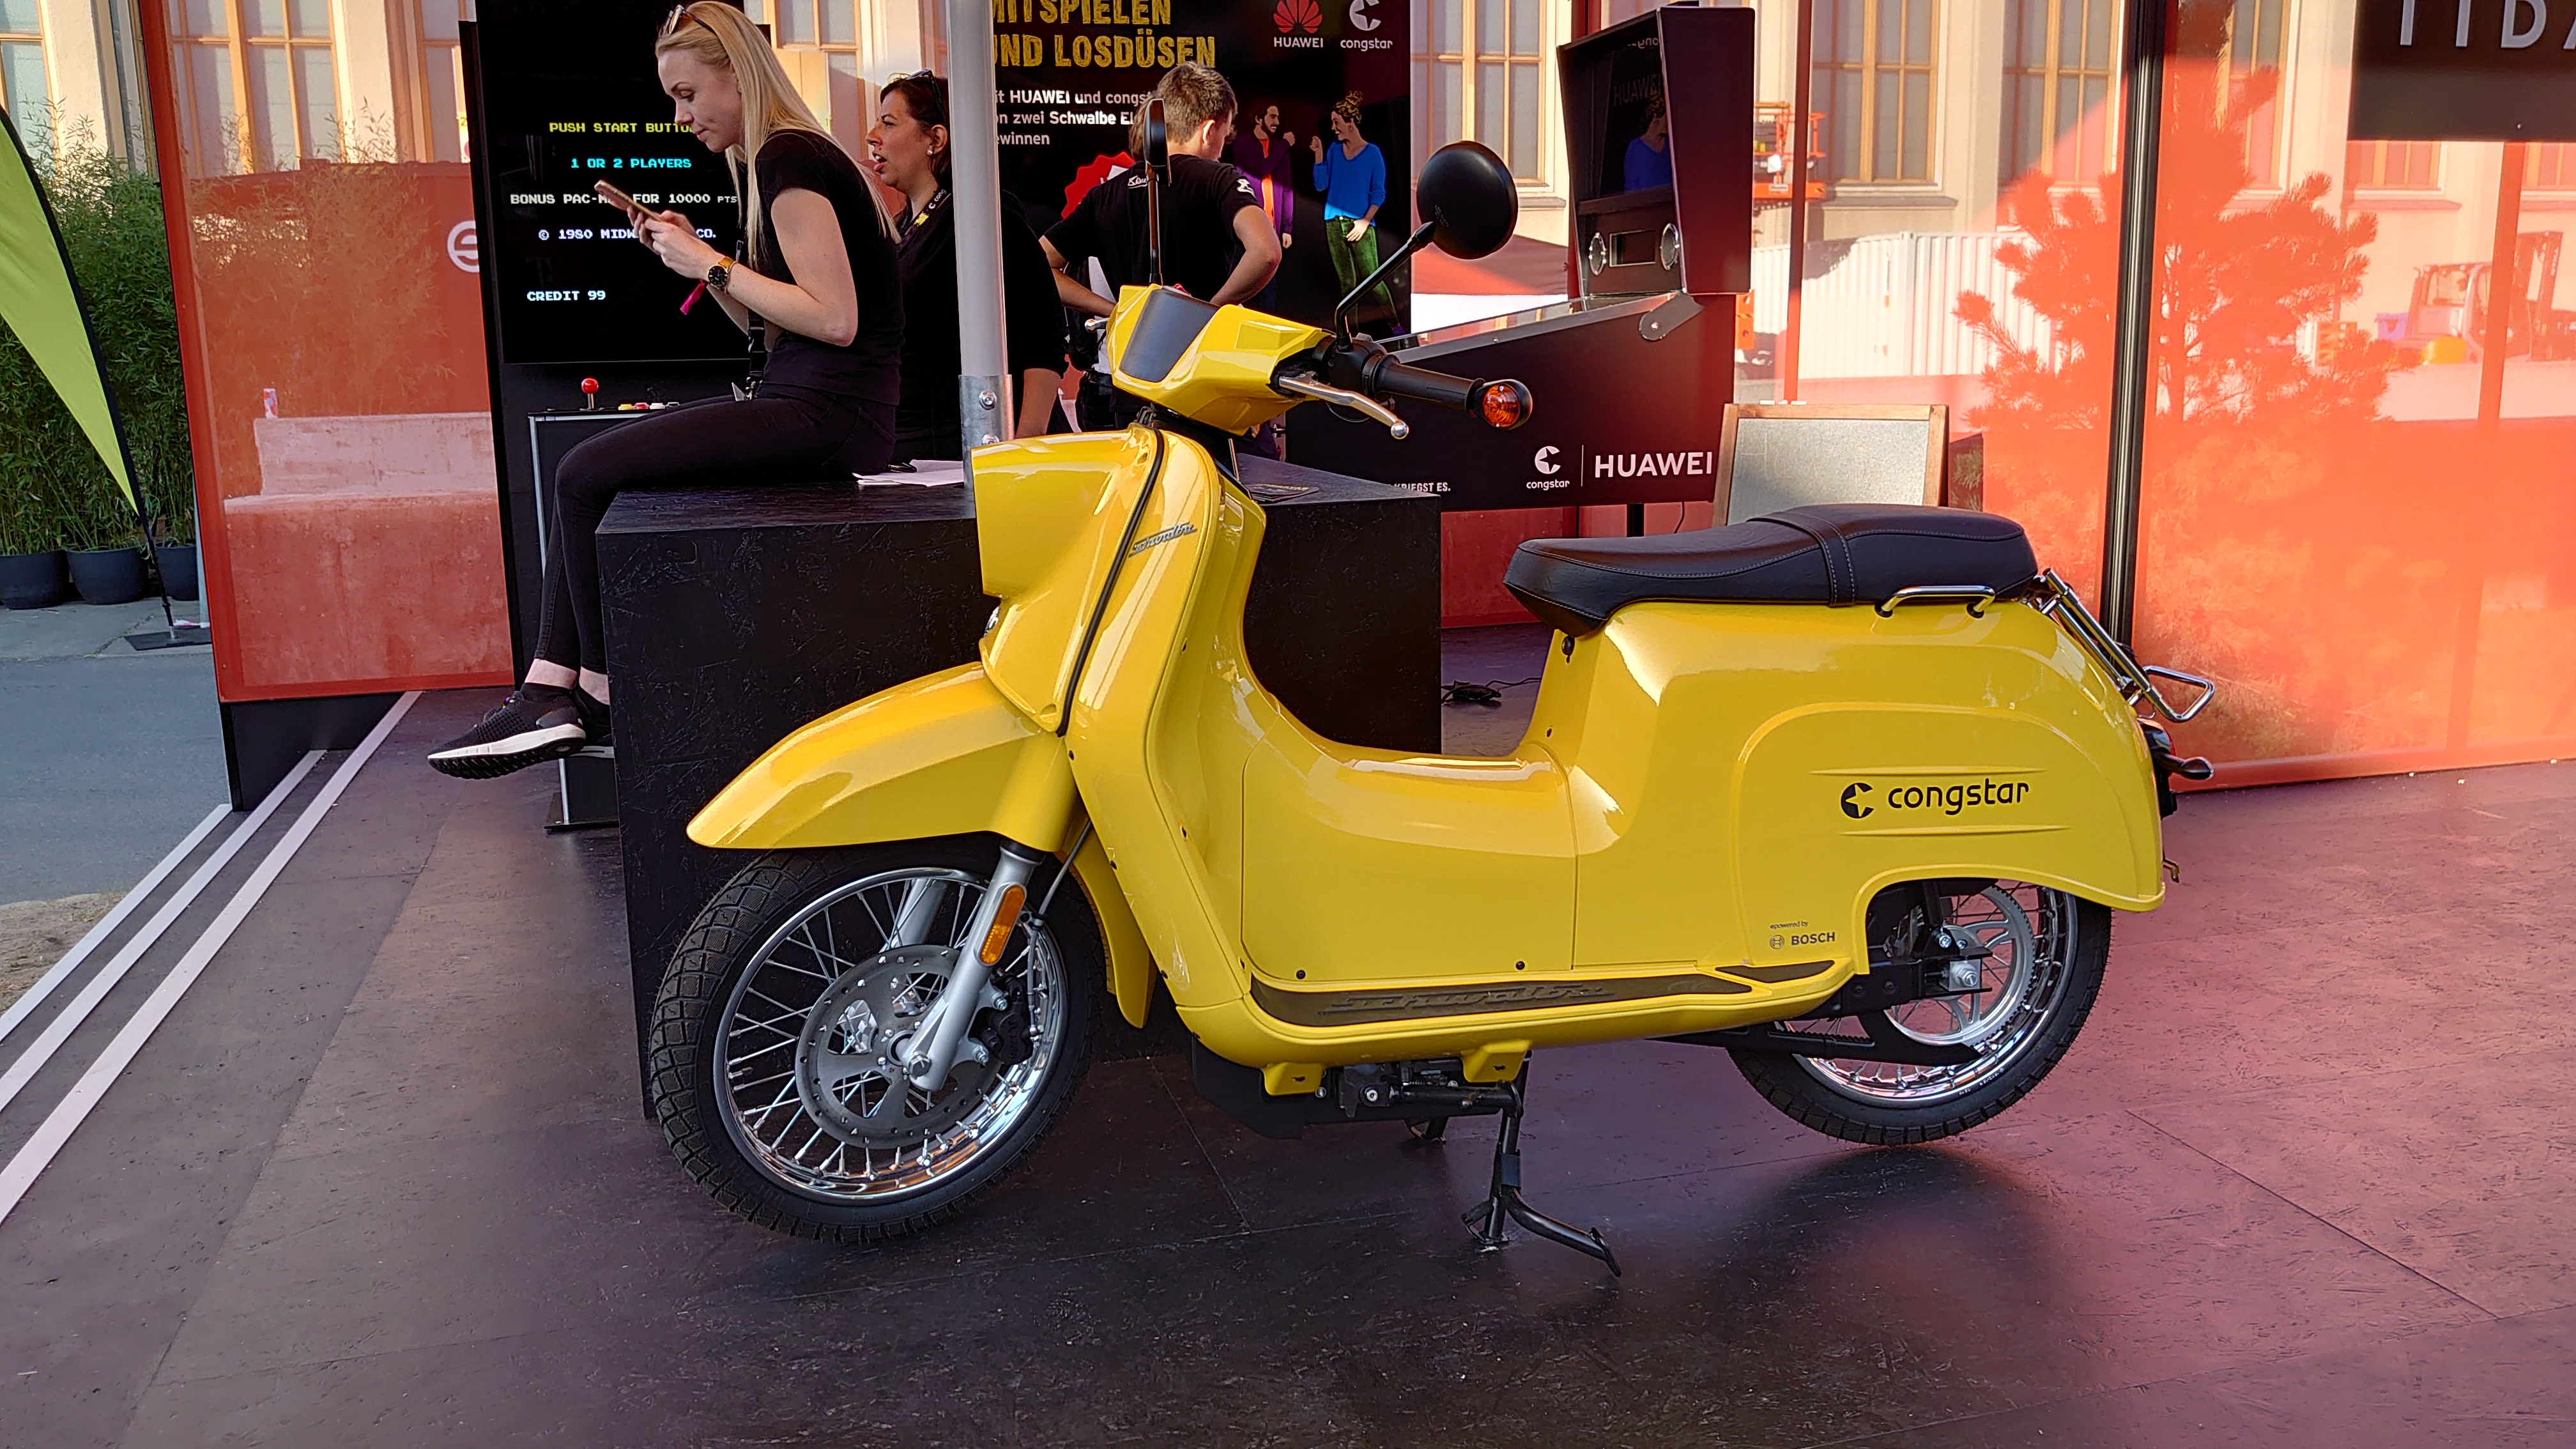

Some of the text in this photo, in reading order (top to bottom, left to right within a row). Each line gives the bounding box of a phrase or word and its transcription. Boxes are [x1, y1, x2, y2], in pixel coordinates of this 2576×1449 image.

[2400, 0, 2576, 50] ID
[993, 28, 1216, 68] ND LOSDÜSEN
[1273, 36, 1324, 48] HUAWEI
[1340, 37, 1393, 52] congstar
[1009, 90, 1070, 104] HUAWEI
[1075, 91, 1101, 104] und
[1013, 111, 1045, 125] zwei
[1049, 111, 1117, 125] Schwalbe
[549, 122, 693, 133] PUSH START BUTTO
[571, 158, 692, 169] 1 OR 2 PLAYERS
[510, 193, 738, 204] BONUS PAC-M FOR 10000 PTS
[558, 228, 594, 239] 1980
[600, 228, 639, 240] MIDW
[696, 227, 717, 238] CO.
[526, 290, 606, 301] CREDIT 99
[1595, 451, 1713, 479] HUAWEI
[1436, 482, 1452, 492] ES.
[1526, 479, 1570, 491] congstar
[1888, 778, 2030, 816] congstar
[1791, 931, 1836, 946] BOSCH
